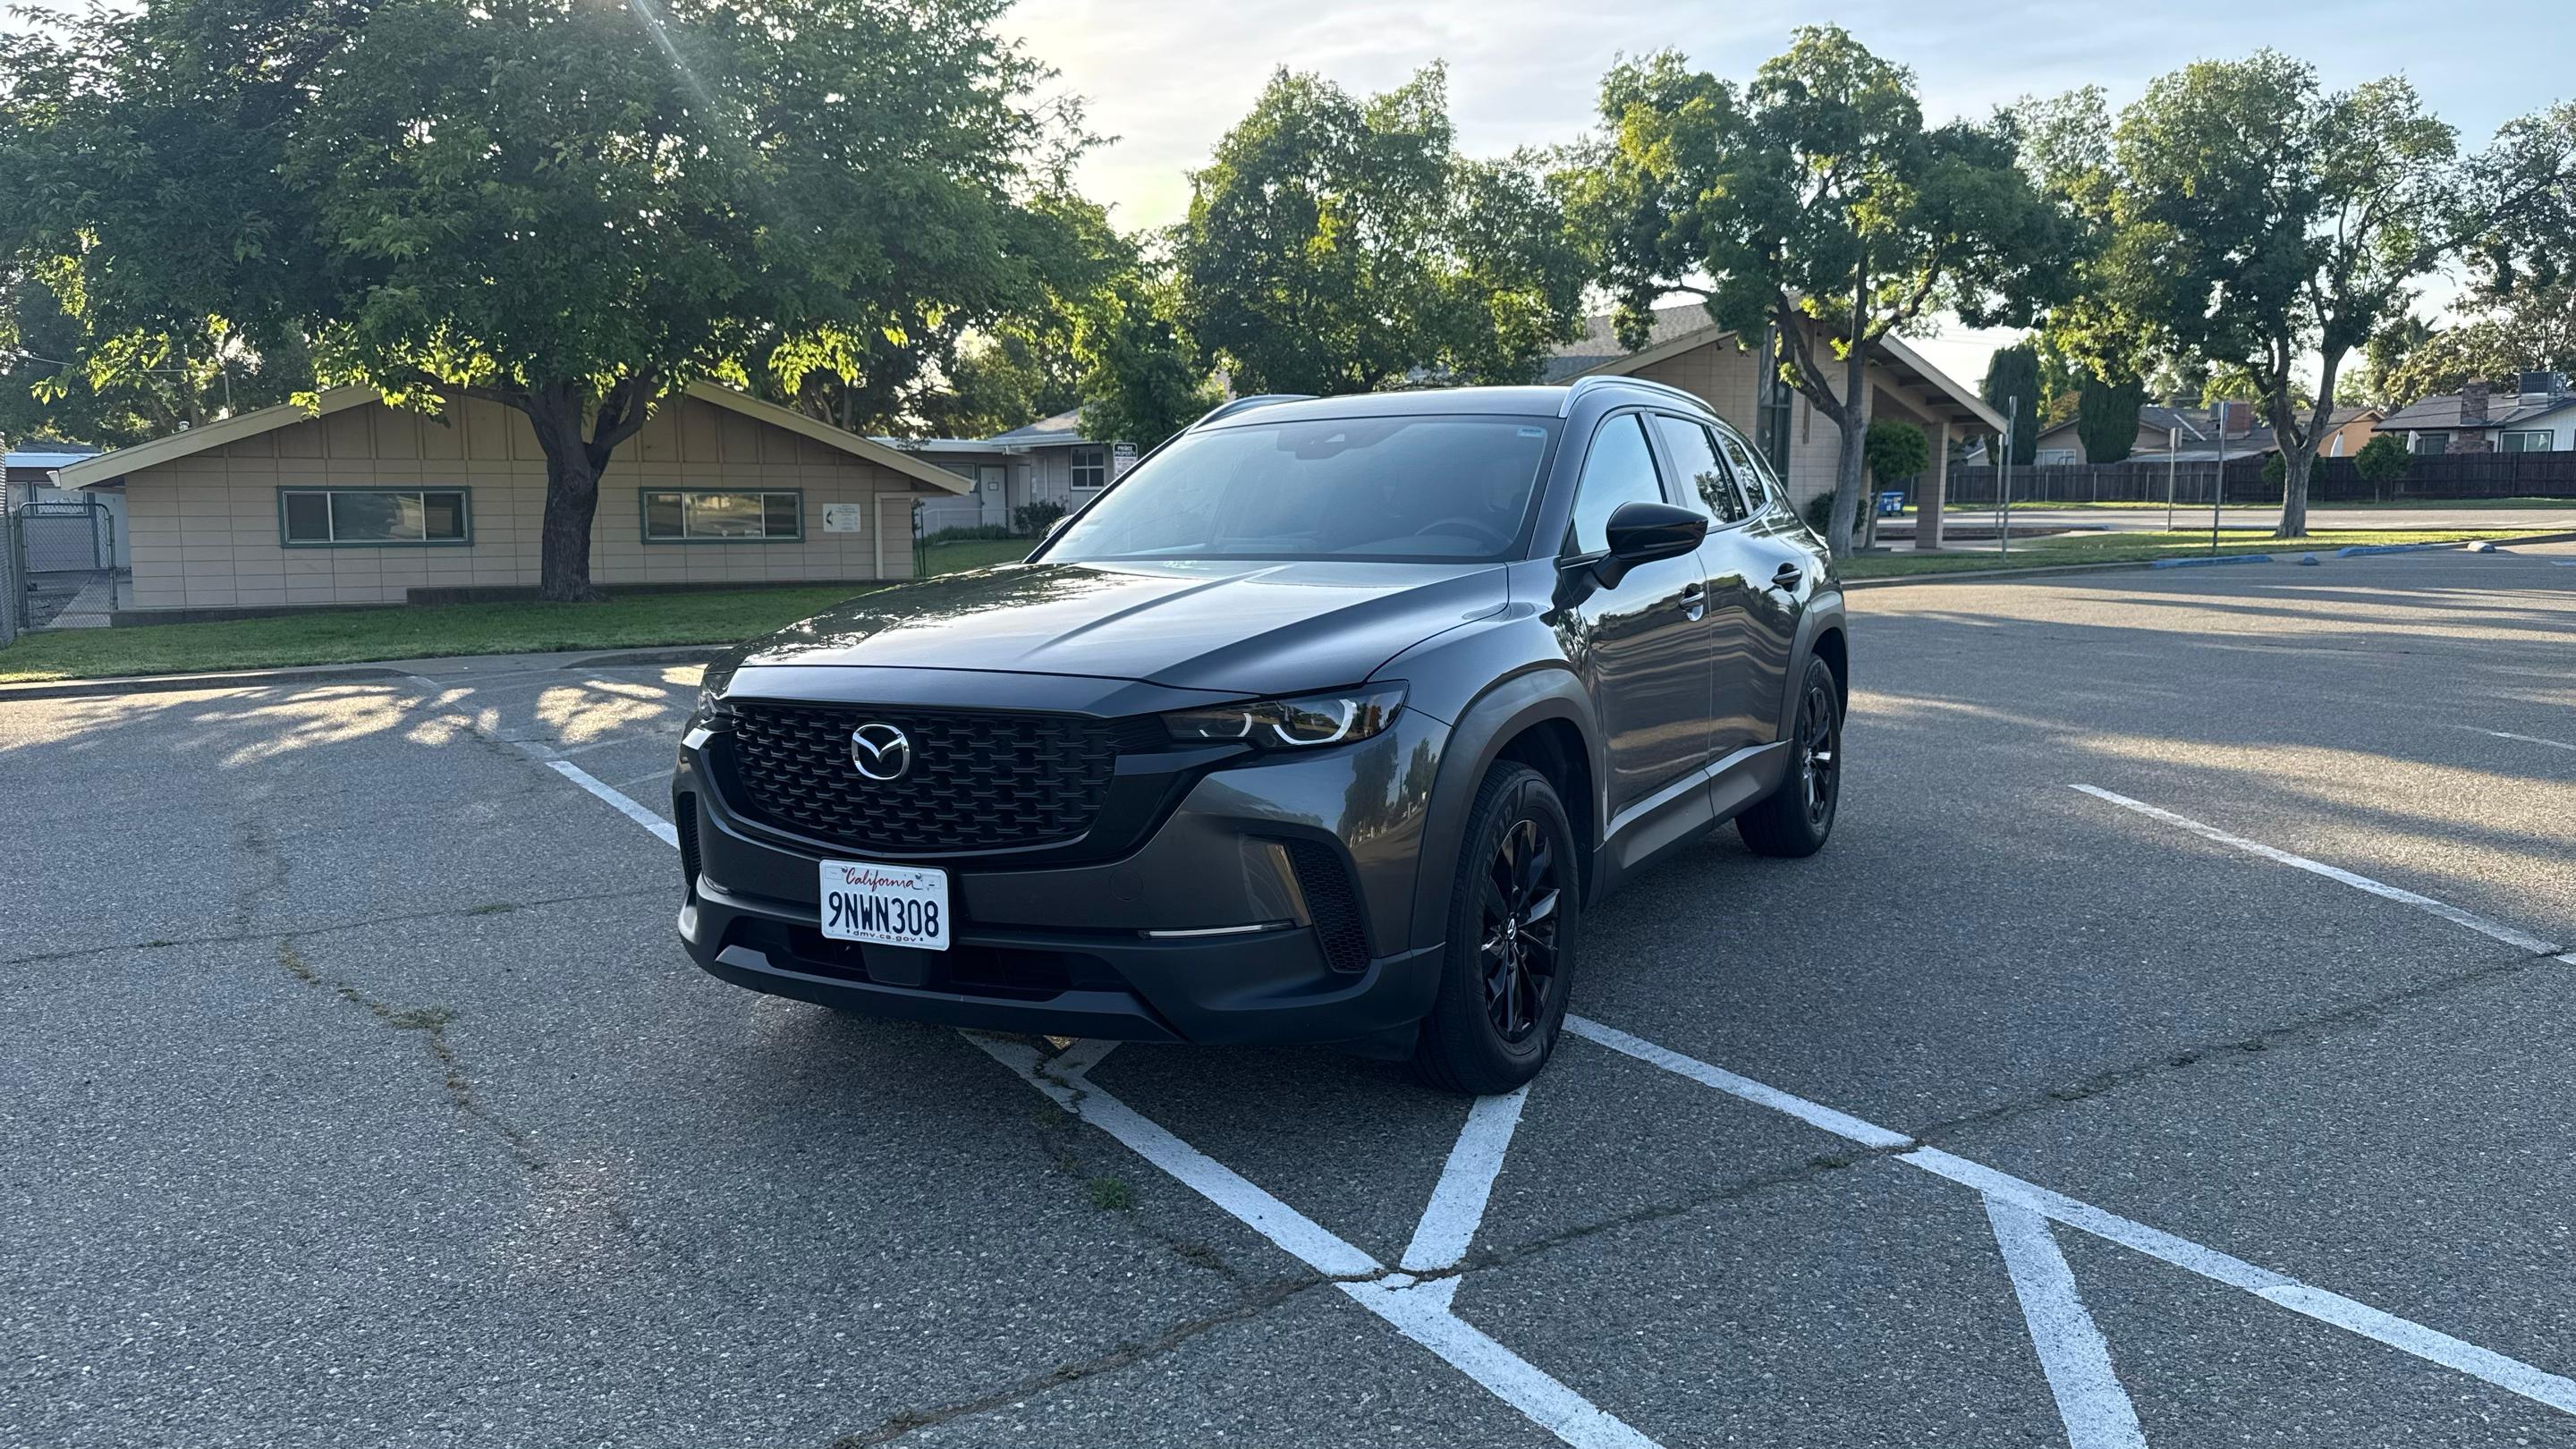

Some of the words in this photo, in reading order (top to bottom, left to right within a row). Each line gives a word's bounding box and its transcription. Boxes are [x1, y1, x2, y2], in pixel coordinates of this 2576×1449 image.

[845, 868, 923, 892] California
[828, 891, 939, 937] 9NWN308
[852, 929, 917, 942] dmv.ca.gov
